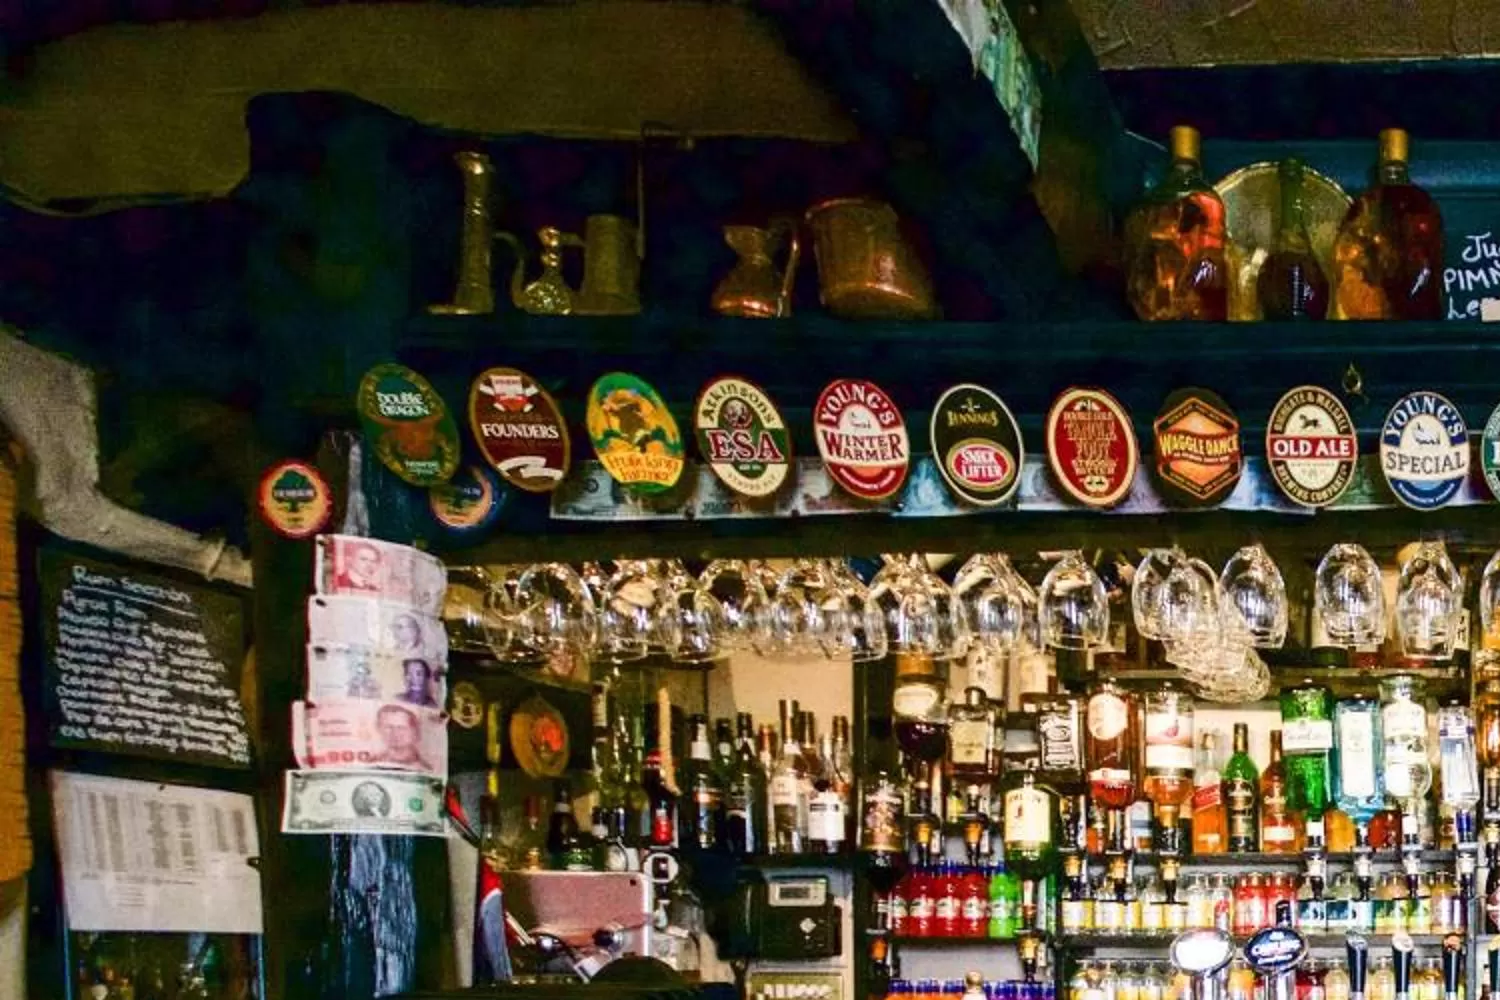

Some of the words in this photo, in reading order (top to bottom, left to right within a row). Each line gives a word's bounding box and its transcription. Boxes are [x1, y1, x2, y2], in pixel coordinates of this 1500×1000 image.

[376, 391, 424, 405] DOUBLE
[380, 402, 430, 417] DRAGON
[702, 382, 776, 424] Atkinsons
[820, 383, 895, 425] YOUNG'S
[1385, 395, 1463, 437] YOUNG'S
[481, 422, 559, 439] FOUNDERS
[822, 430, 903, 453] WINTER
[706, 428, 784, 463] ESA
[1273, 439, 1312, 457] OLD
[1315, 439, 1350, 457] ALE
[1386, 450, 1465, 475] SPECIAL
